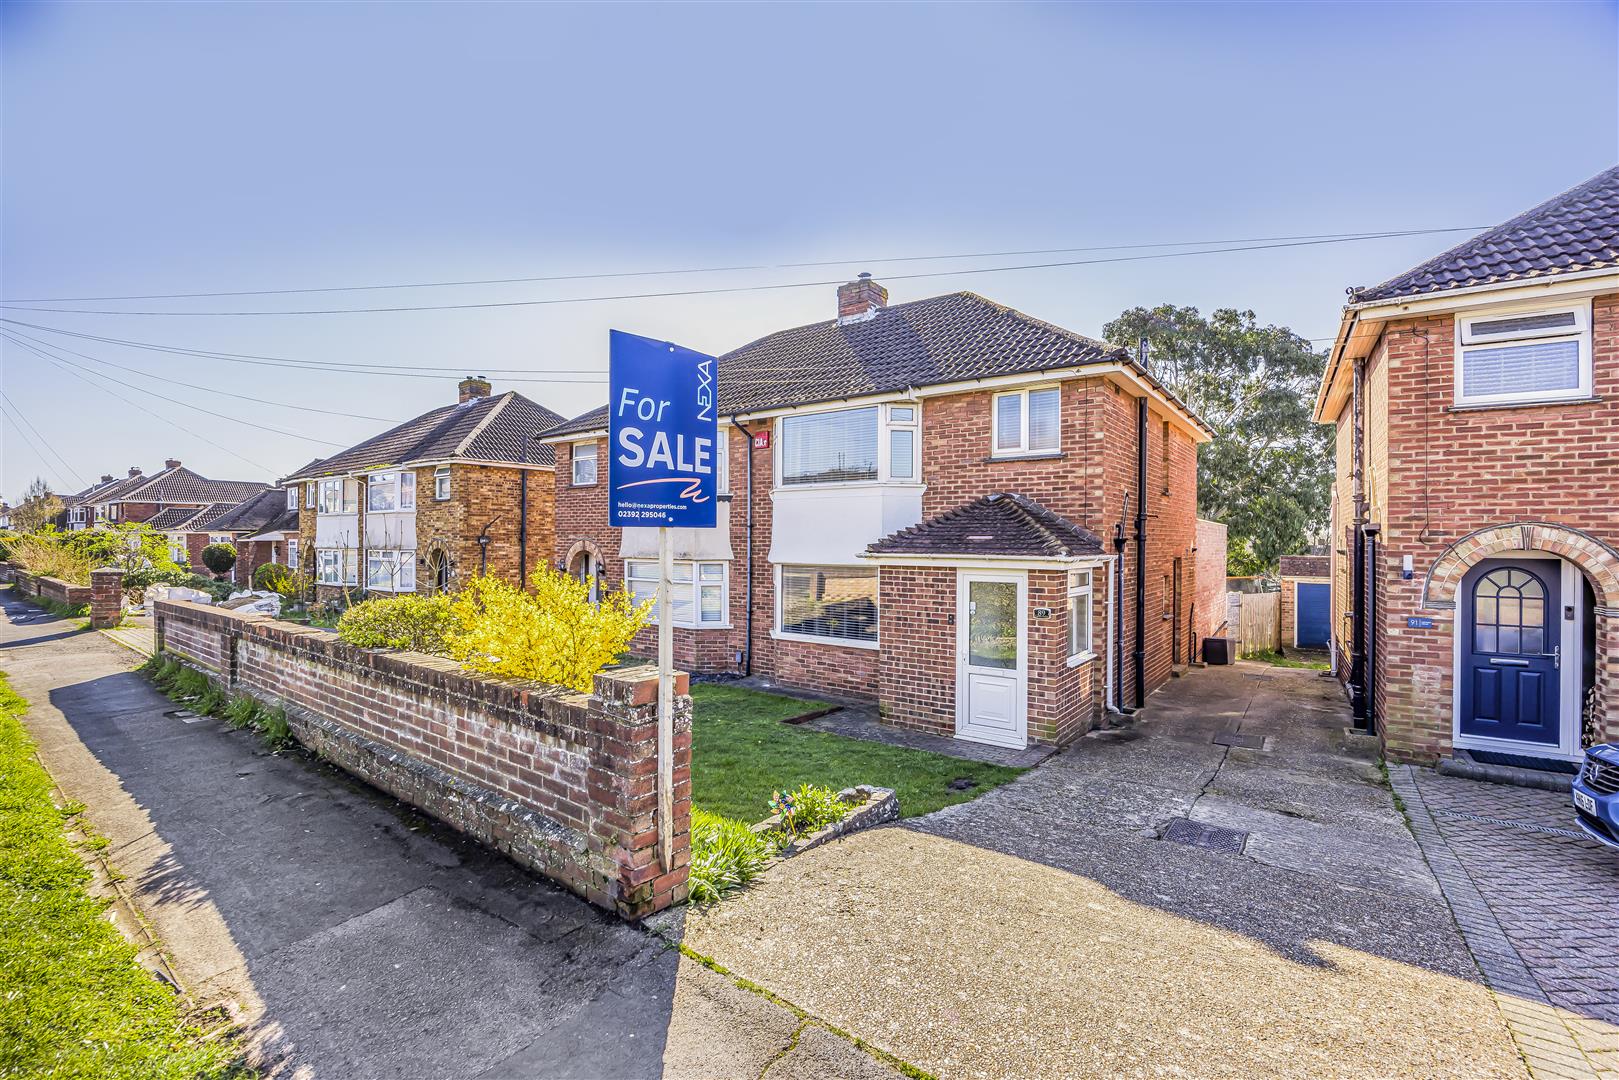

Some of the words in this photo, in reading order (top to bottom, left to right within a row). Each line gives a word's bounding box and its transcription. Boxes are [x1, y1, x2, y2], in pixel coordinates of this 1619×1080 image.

[618, 387, 671, 422] For
[697, 360, 713, 422] NEXA
[618, 426, 712, 474] SALE
[617, 501, 688, 510] hello@nexaproperties.com
[617, 510, 640, 518] 02392
[641, 511, 667, 519] 295046
